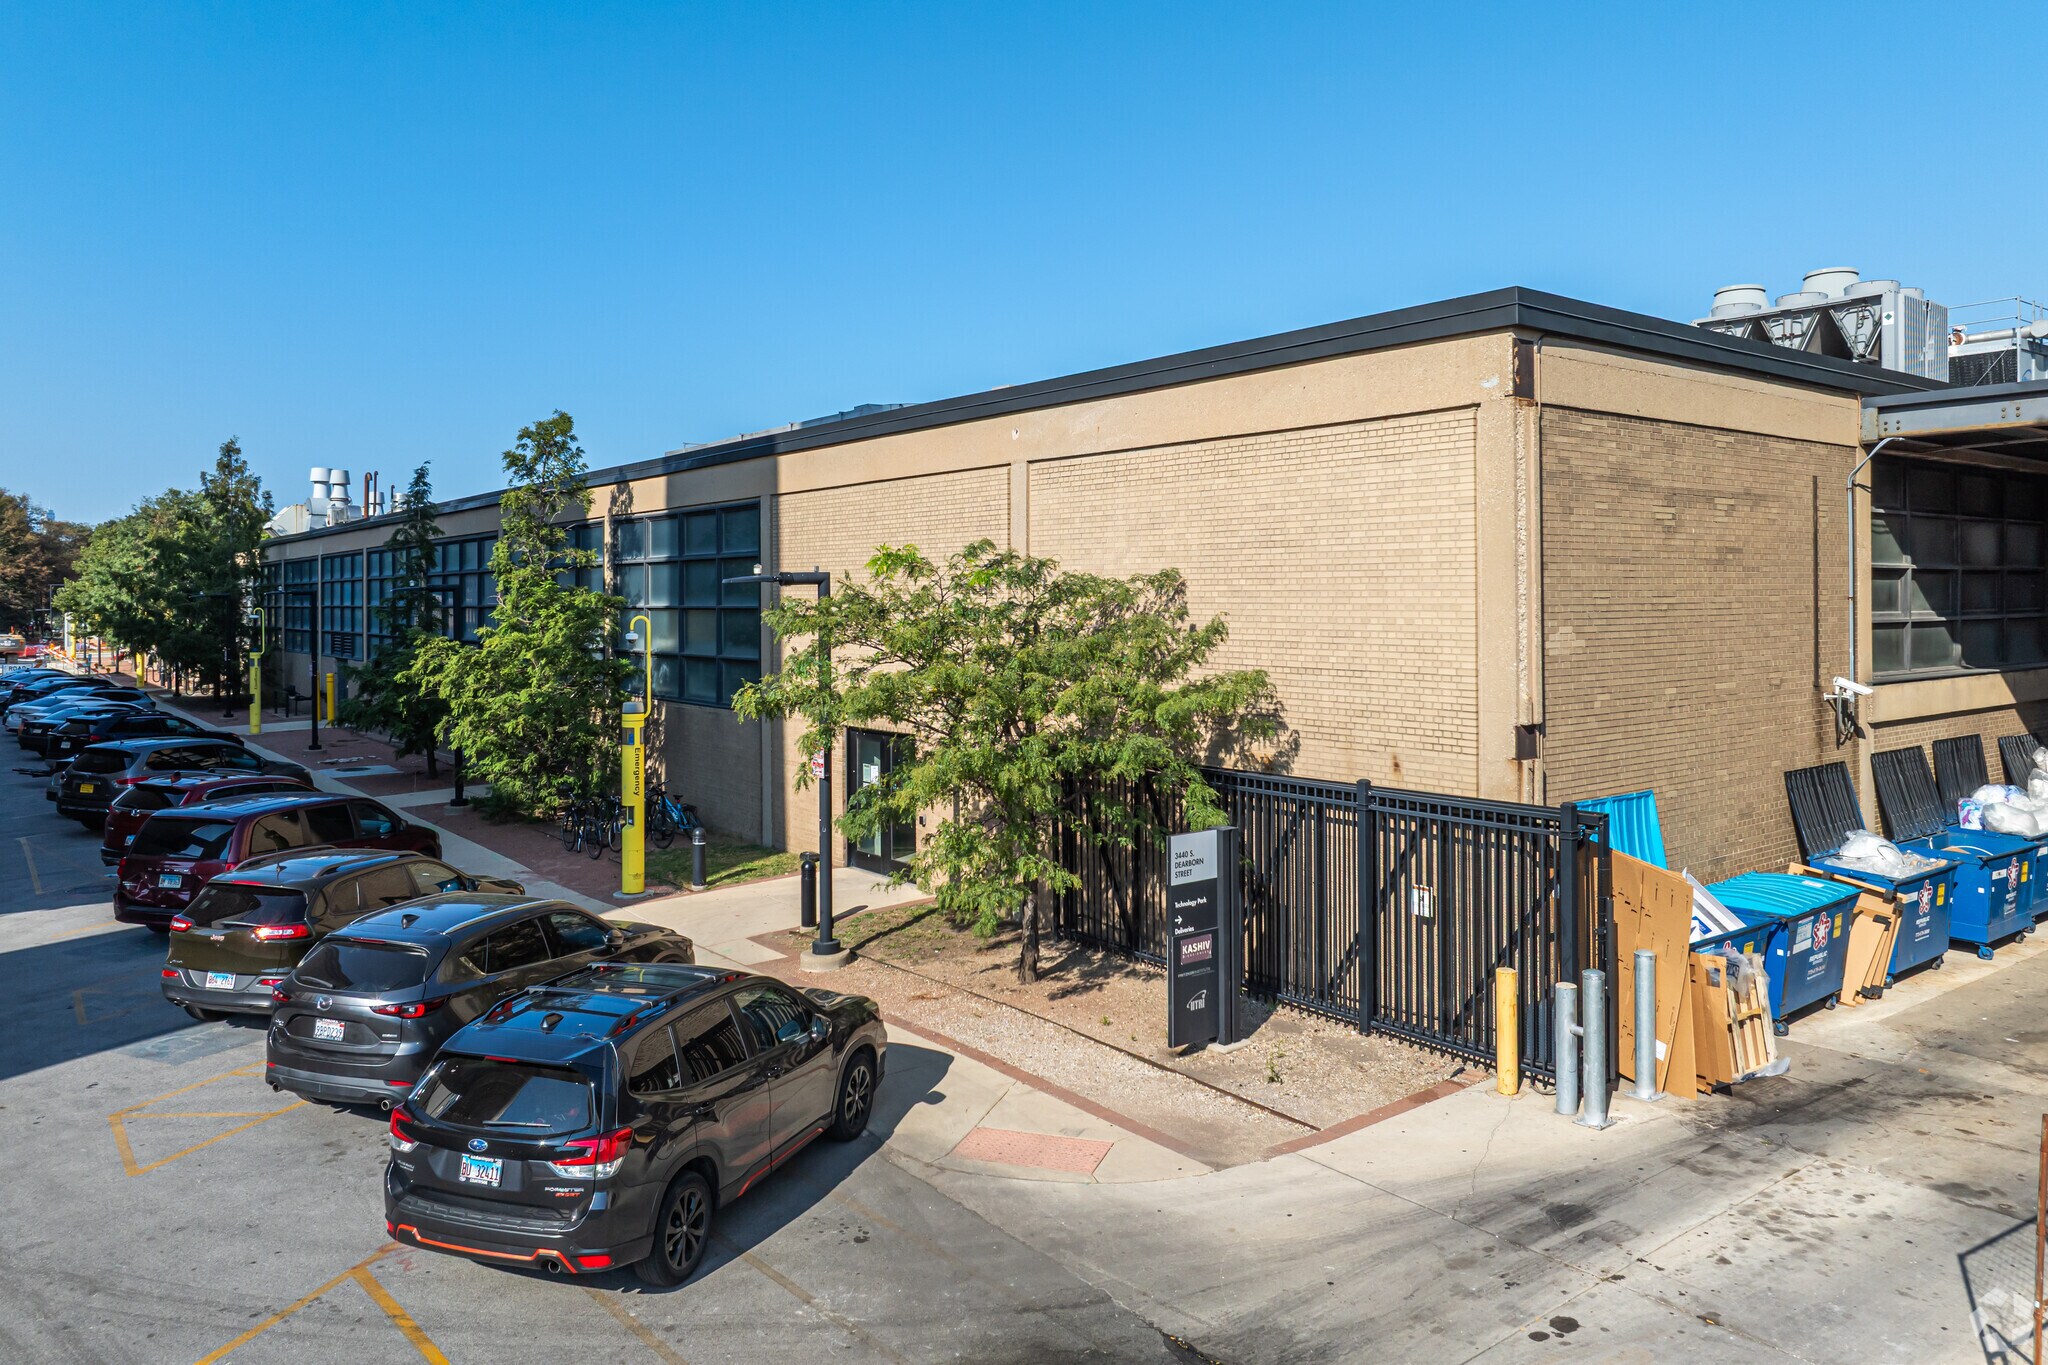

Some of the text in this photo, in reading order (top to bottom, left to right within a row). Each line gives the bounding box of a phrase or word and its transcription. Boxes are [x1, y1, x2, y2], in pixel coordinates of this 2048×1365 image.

[633, 747, 641, 796] Emergency
[1174, 849, 1195, 860] 3440 S.
[1174, 858, 1204, 869] DEARBORN
[1174, 869, 1193, 878] STREET
[1174, 896, 1208, 909] Technology Park
[1174, 926, 1195, 935] Deliveries
[210, 934, 225, 942] Jeep
[1182, 940, 1211, 954] KASHIV
[474, 1164, 500, 1180] 32411
